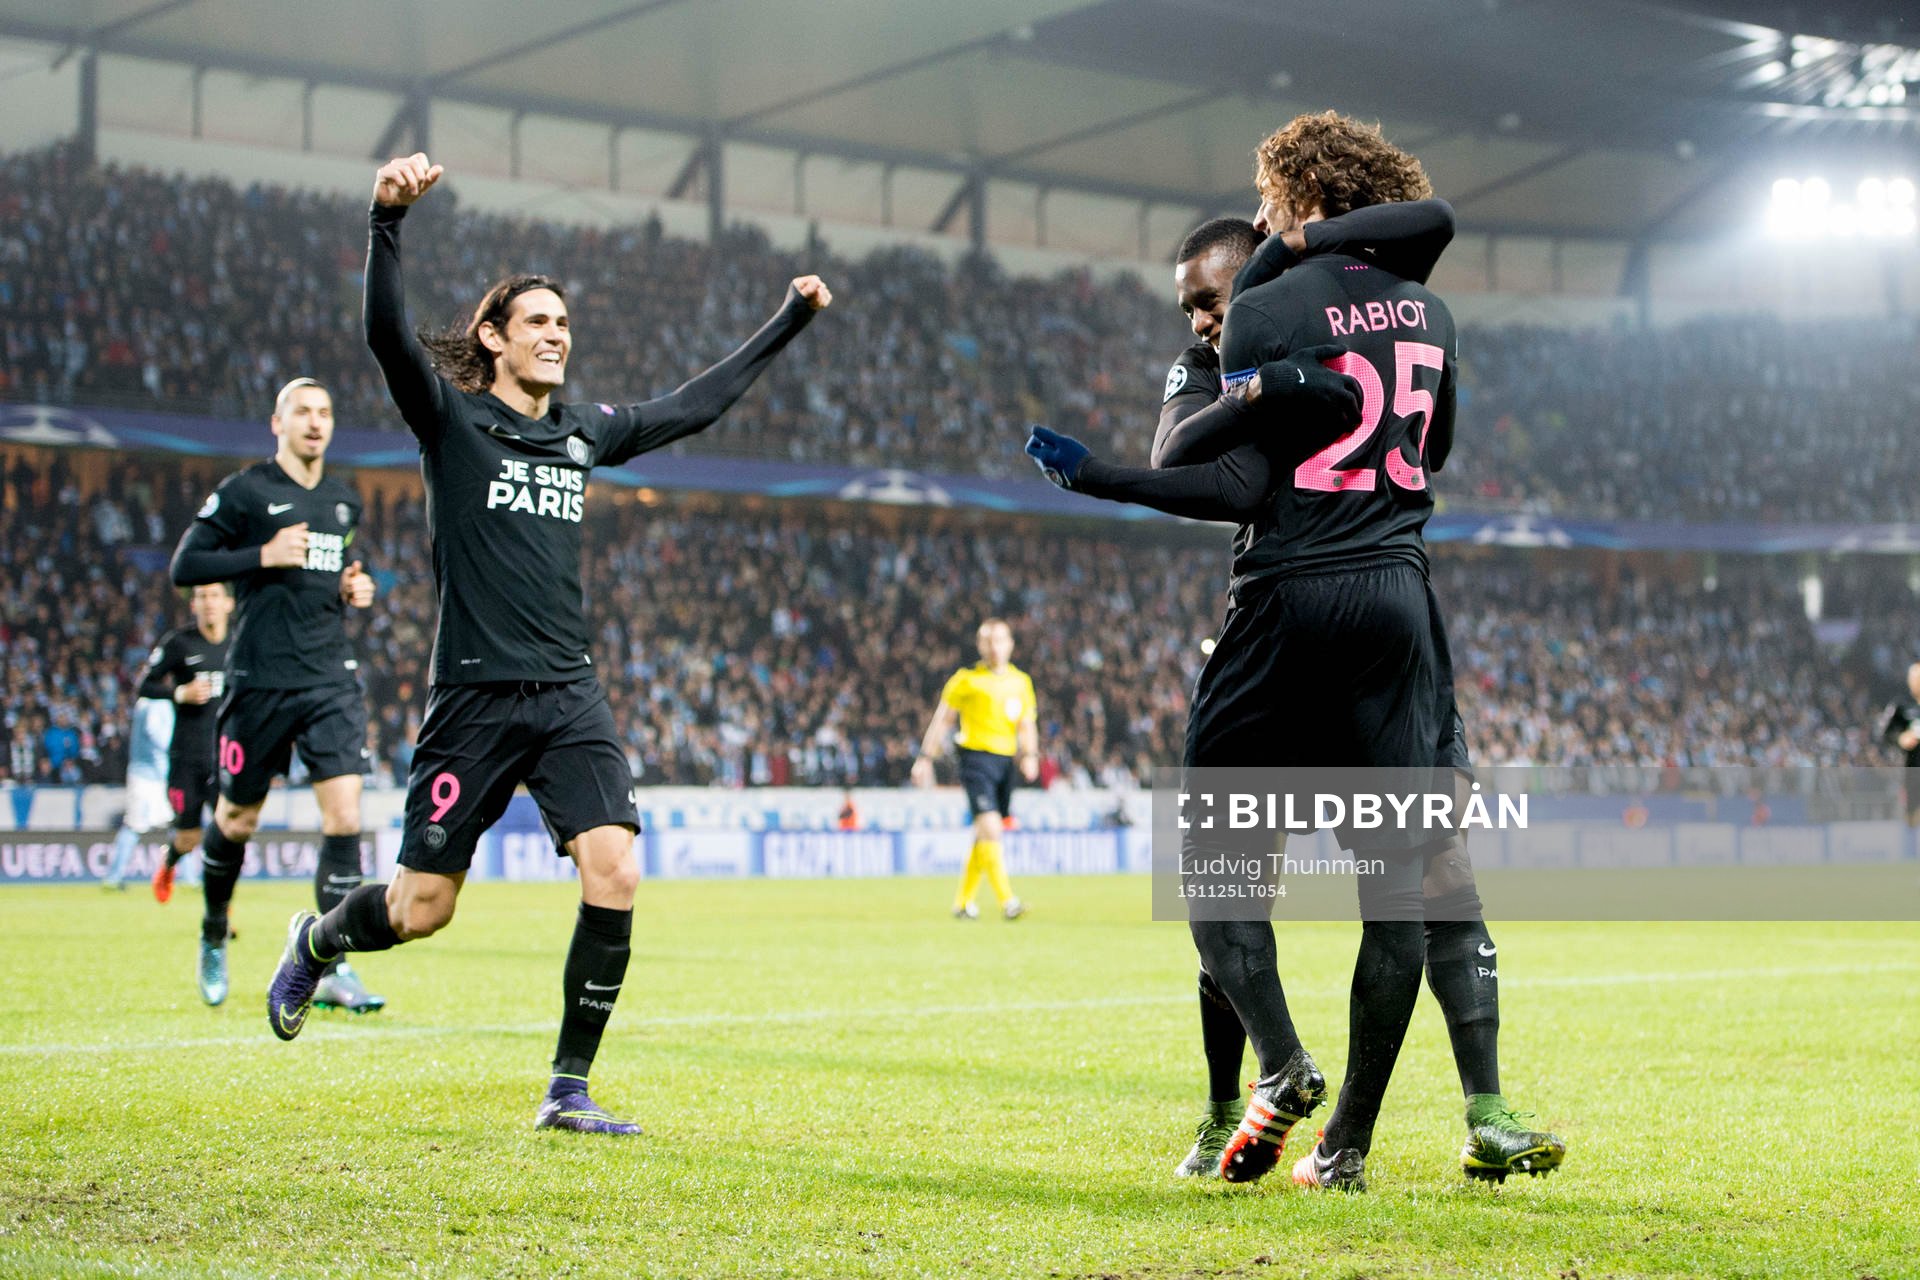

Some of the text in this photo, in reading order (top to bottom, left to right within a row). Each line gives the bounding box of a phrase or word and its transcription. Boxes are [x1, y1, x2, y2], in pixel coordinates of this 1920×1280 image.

[1325, 299, 1427, 336] RABIOT
[1294, 341, 1444, 492] 25
[499, 459, 584, 493] JE SUIS
[487, 480, 585, 523] PARIS
[219, 735, 245, 775] 10
[429, 772, 461, 823] 9
[2, 843, 84, 878] UEFA
